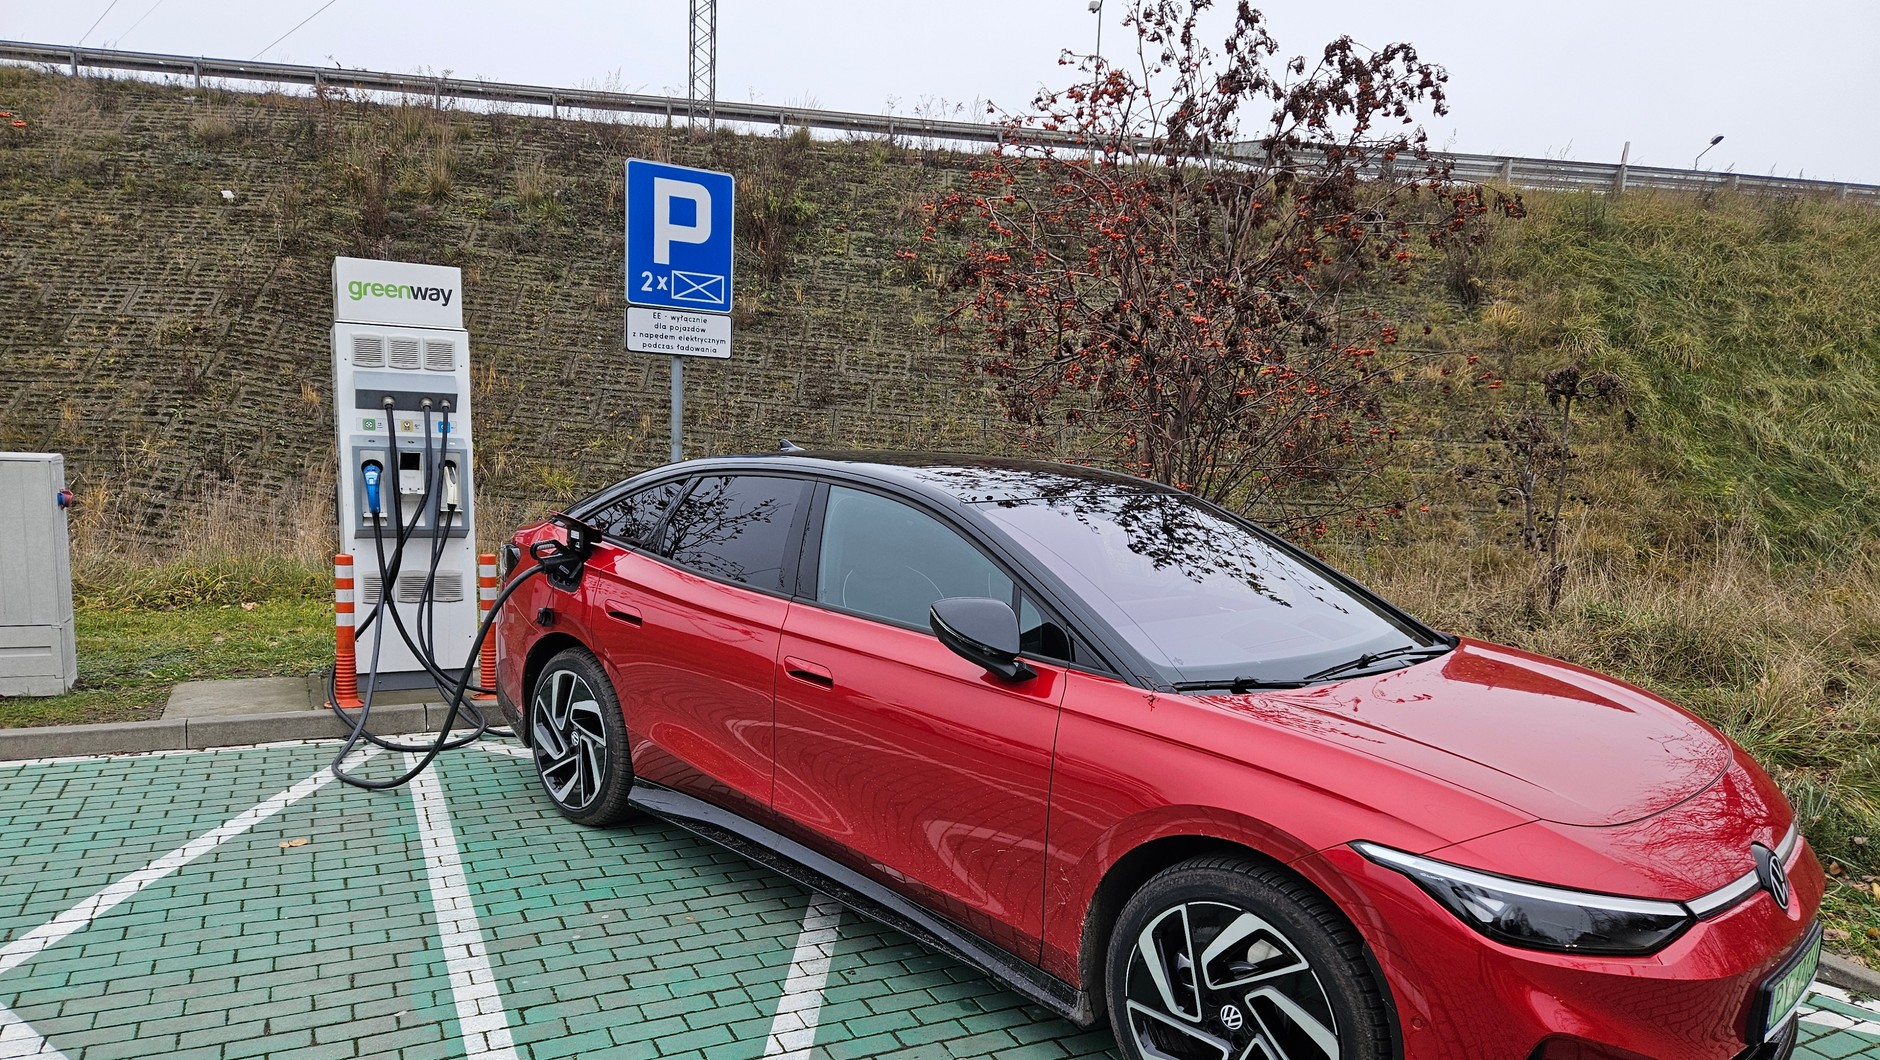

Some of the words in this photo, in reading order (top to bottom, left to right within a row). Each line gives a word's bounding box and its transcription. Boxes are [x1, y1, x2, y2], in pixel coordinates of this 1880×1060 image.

[653, 177, 712, 265] P
[348, 280, 453, 307] greenway
[671, 314, 708, 324] wyłącznie
[654, 322, 667, 330] dla
[669, 323, 706, 333] pojazdów
[639, 331, 675, 341] napędem
[678, 334, 726, 346] elektrycznym
[642, 341, 674, 350] podczas
[676, 343, 717, 353] ładowania
